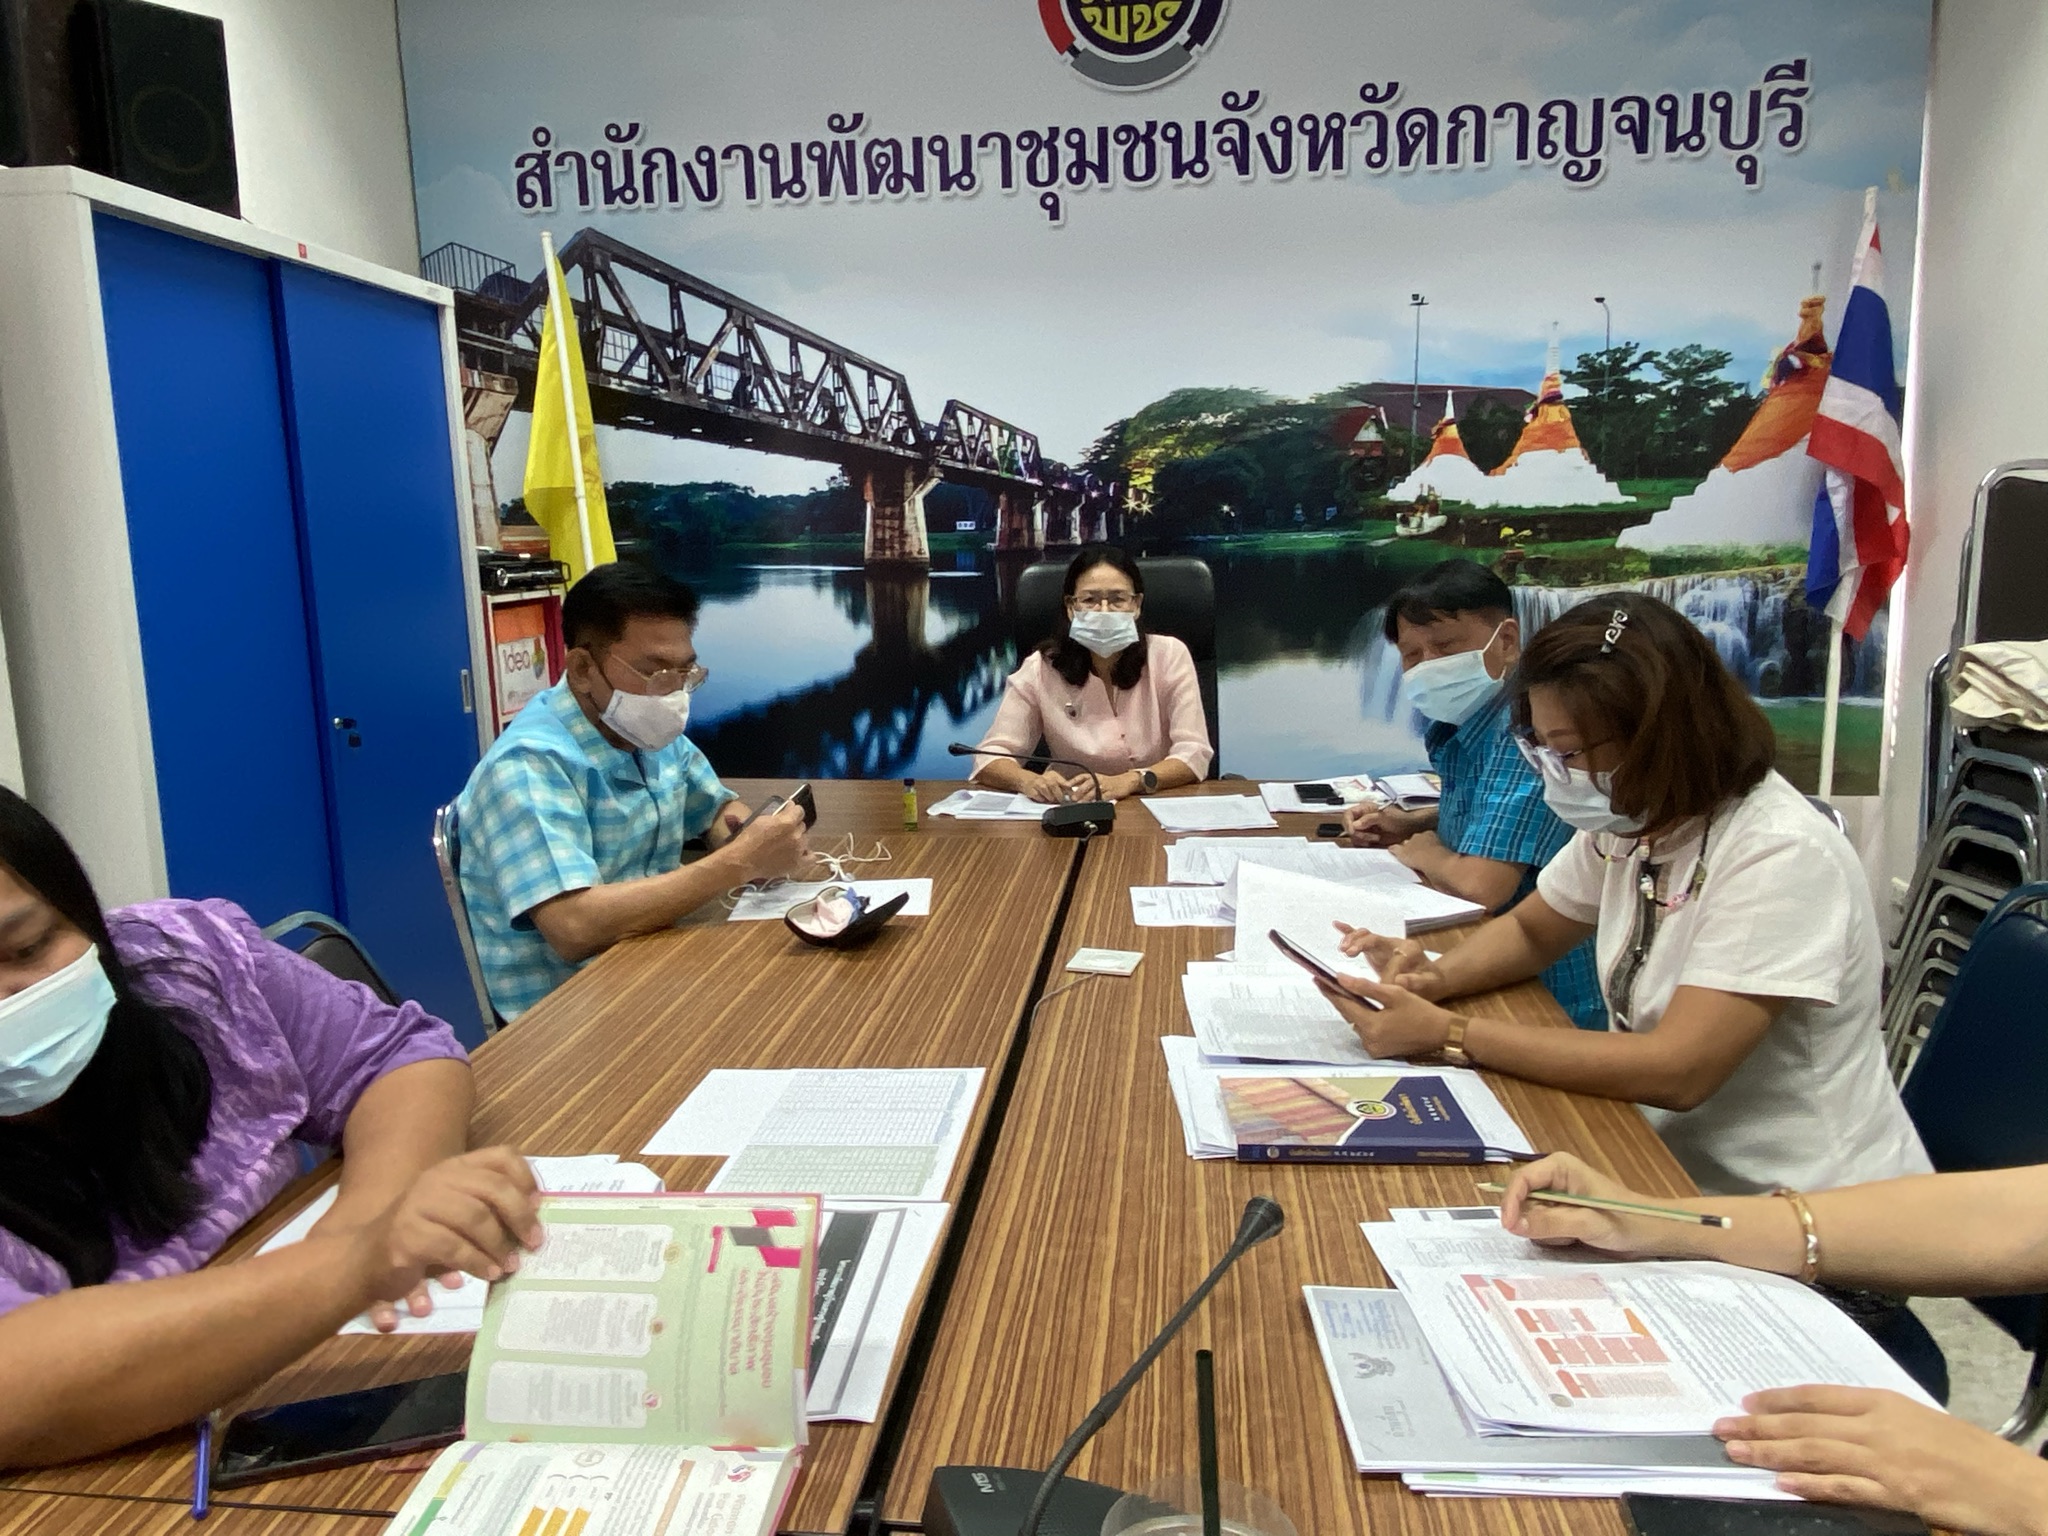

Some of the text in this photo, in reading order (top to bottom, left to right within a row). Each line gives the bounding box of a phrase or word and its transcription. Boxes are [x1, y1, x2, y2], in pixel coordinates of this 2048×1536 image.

[514, 58, 1809, 222] สำนักงานพัฒนาชุมชนจังหวัดกาญจนบุรี
